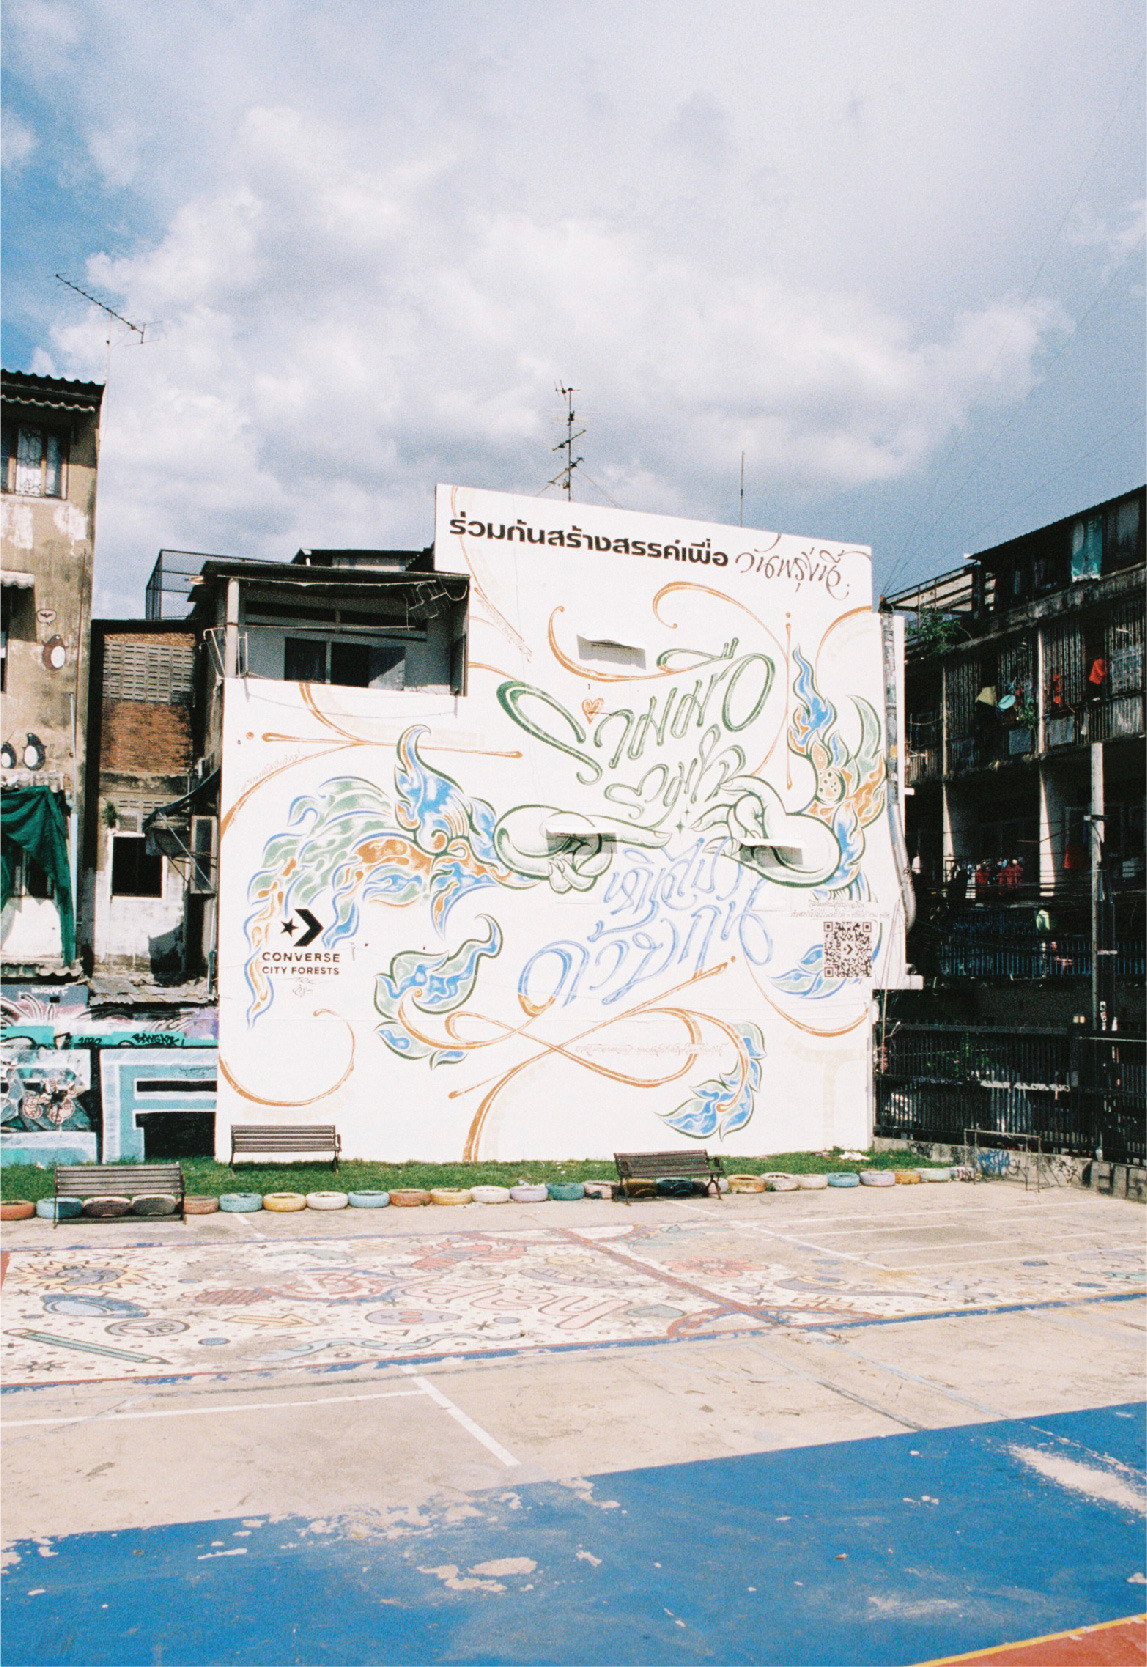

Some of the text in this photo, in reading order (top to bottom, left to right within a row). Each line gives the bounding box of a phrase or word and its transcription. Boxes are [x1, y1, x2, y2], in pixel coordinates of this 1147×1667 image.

[449, 511, 728, 566] ร่วมกันสร้างสรรค์เพื่อ
[262, 952, 341, 963] CONVERSE
[262, 966, 340, 976] CITY FORESTS
